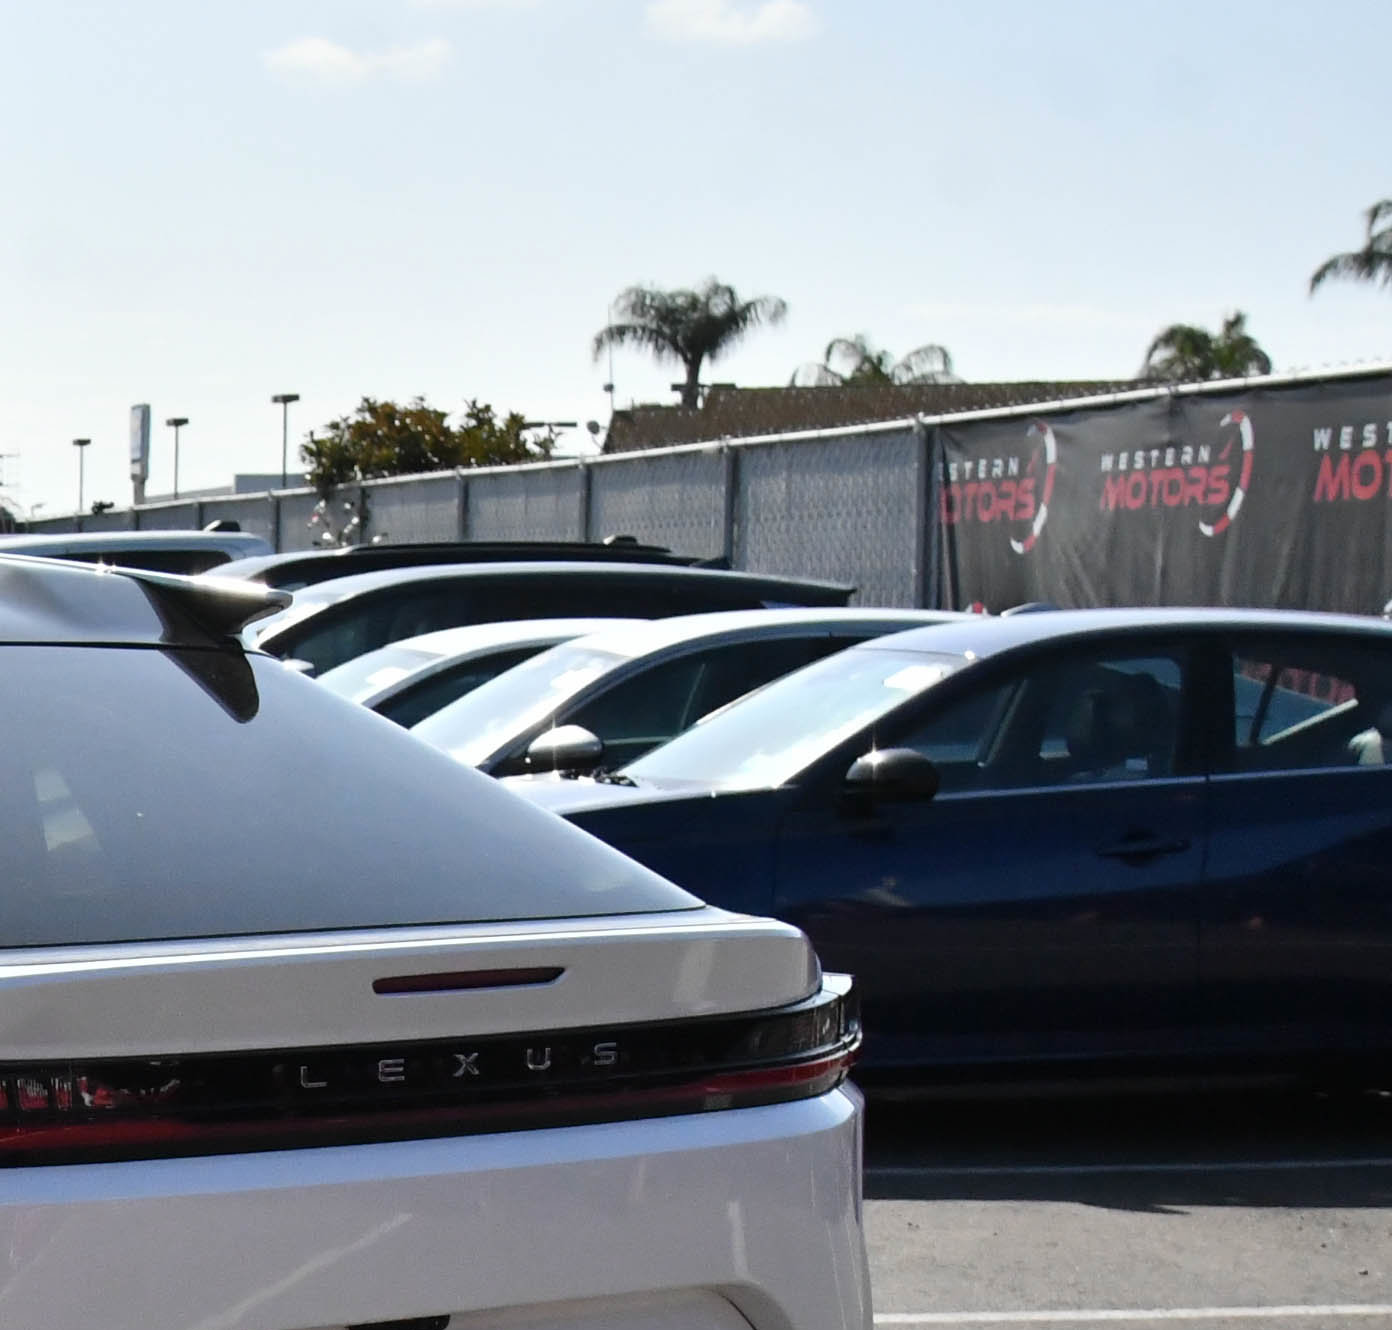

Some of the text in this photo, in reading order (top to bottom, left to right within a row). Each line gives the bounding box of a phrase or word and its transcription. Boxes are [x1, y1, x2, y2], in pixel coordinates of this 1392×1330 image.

[1101, 444, 1211, 472] WESTERN
[1099, 464, 1231, 512] MOTORS
[299, 1042, 617, 1089] LEXUS
